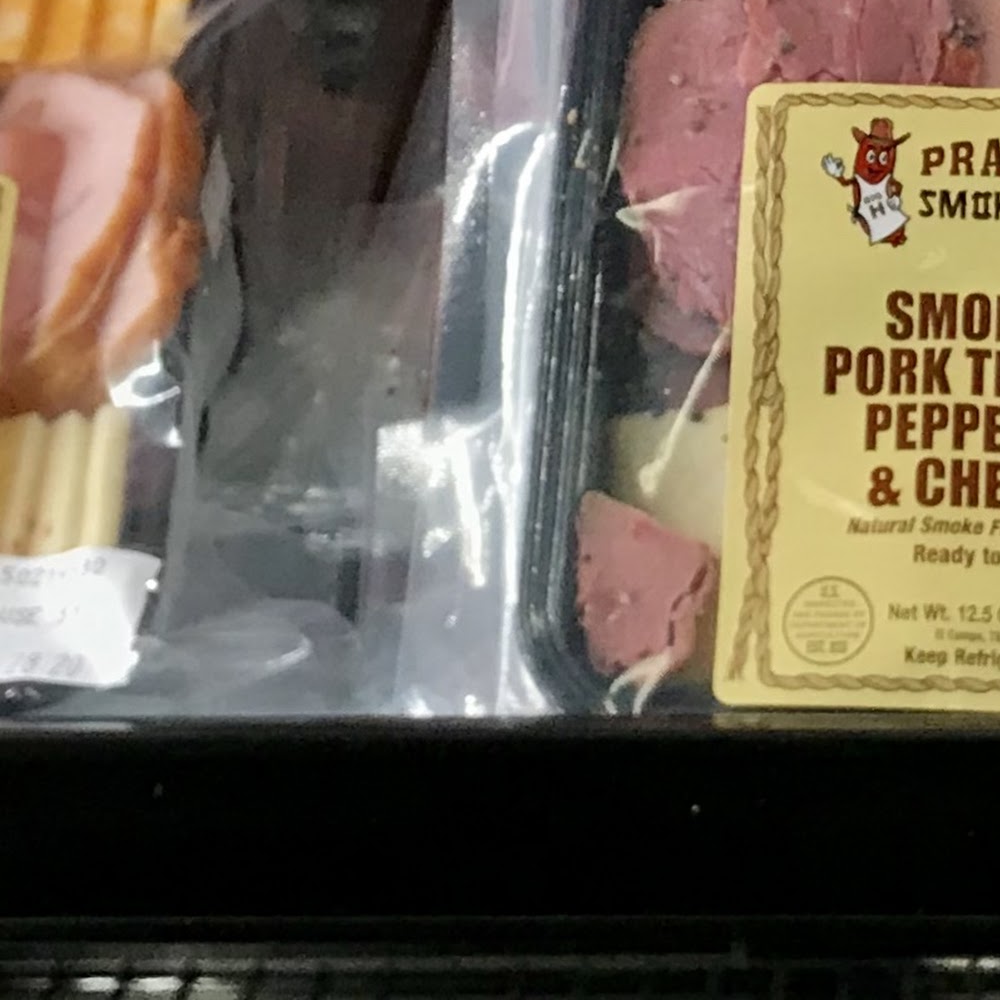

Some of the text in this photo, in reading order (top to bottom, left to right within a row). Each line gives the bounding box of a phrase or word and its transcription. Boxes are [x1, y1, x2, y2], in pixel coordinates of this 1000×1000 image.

[824, 346, 952, 396] PORK
[867, 466, 900, 507] &
[847, 516, 915, 535] Natural
[920, 516, 984, 535] Smoke
[913, 544, 975, 568] Ready
[888, 603, 917, 621] Net
[958, 605, 993, 623] 12.5
[904, 646, 947, 667] Keep
